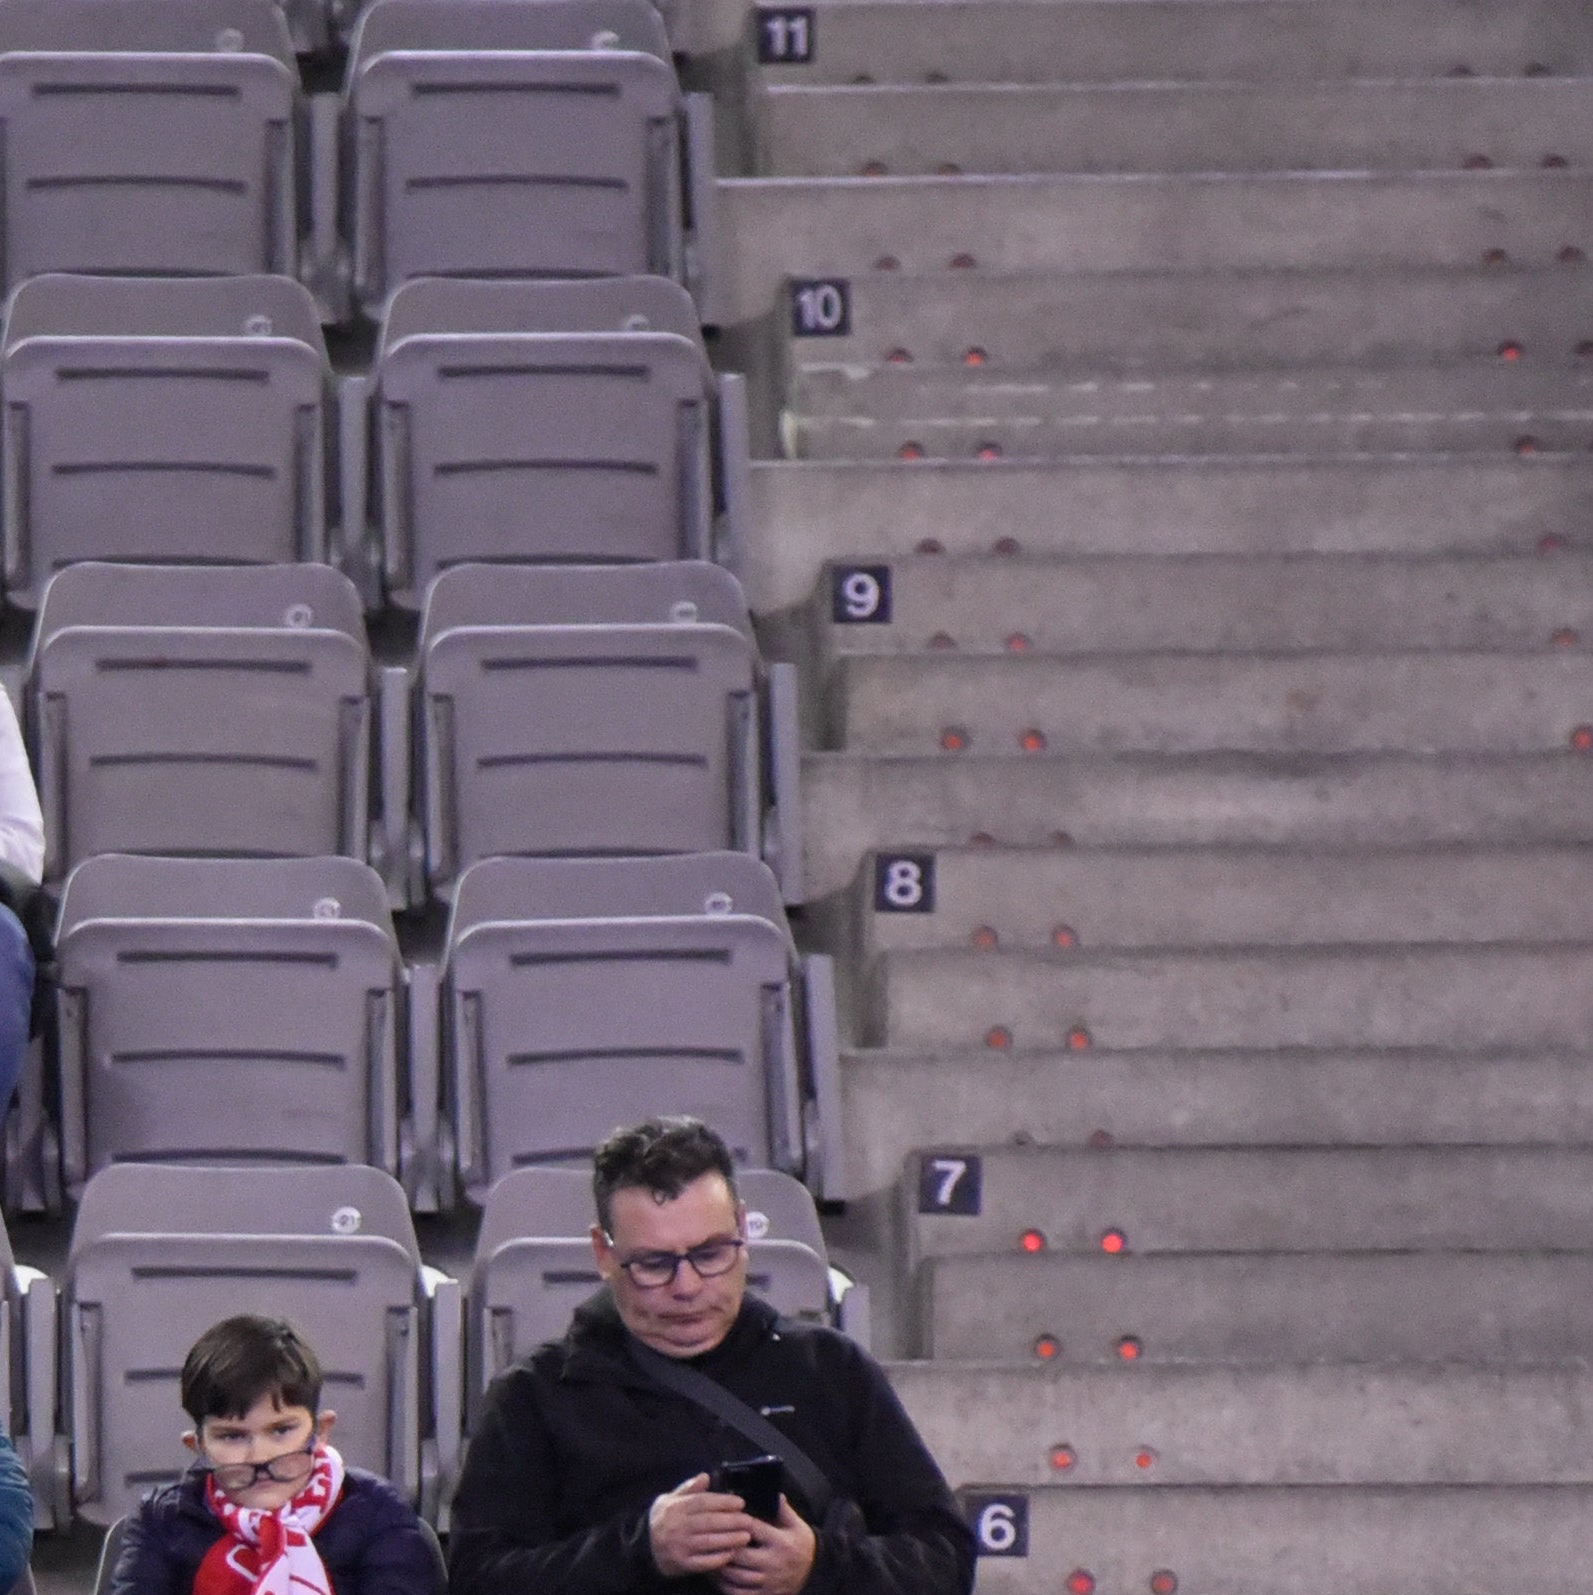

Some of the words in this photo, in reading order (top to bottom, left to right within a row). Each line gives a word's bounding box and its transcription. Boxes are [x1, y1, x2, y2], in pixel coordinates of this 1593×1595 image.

[766, 20, 806, 54] 11
[797, 288, 841, 329] 10
[844, 573, 880, 618] 9
[886, 862, 922, 906] 8
[933, 1160, 968, 1206] 7
[980, 1504, 1015, 1550] 6
